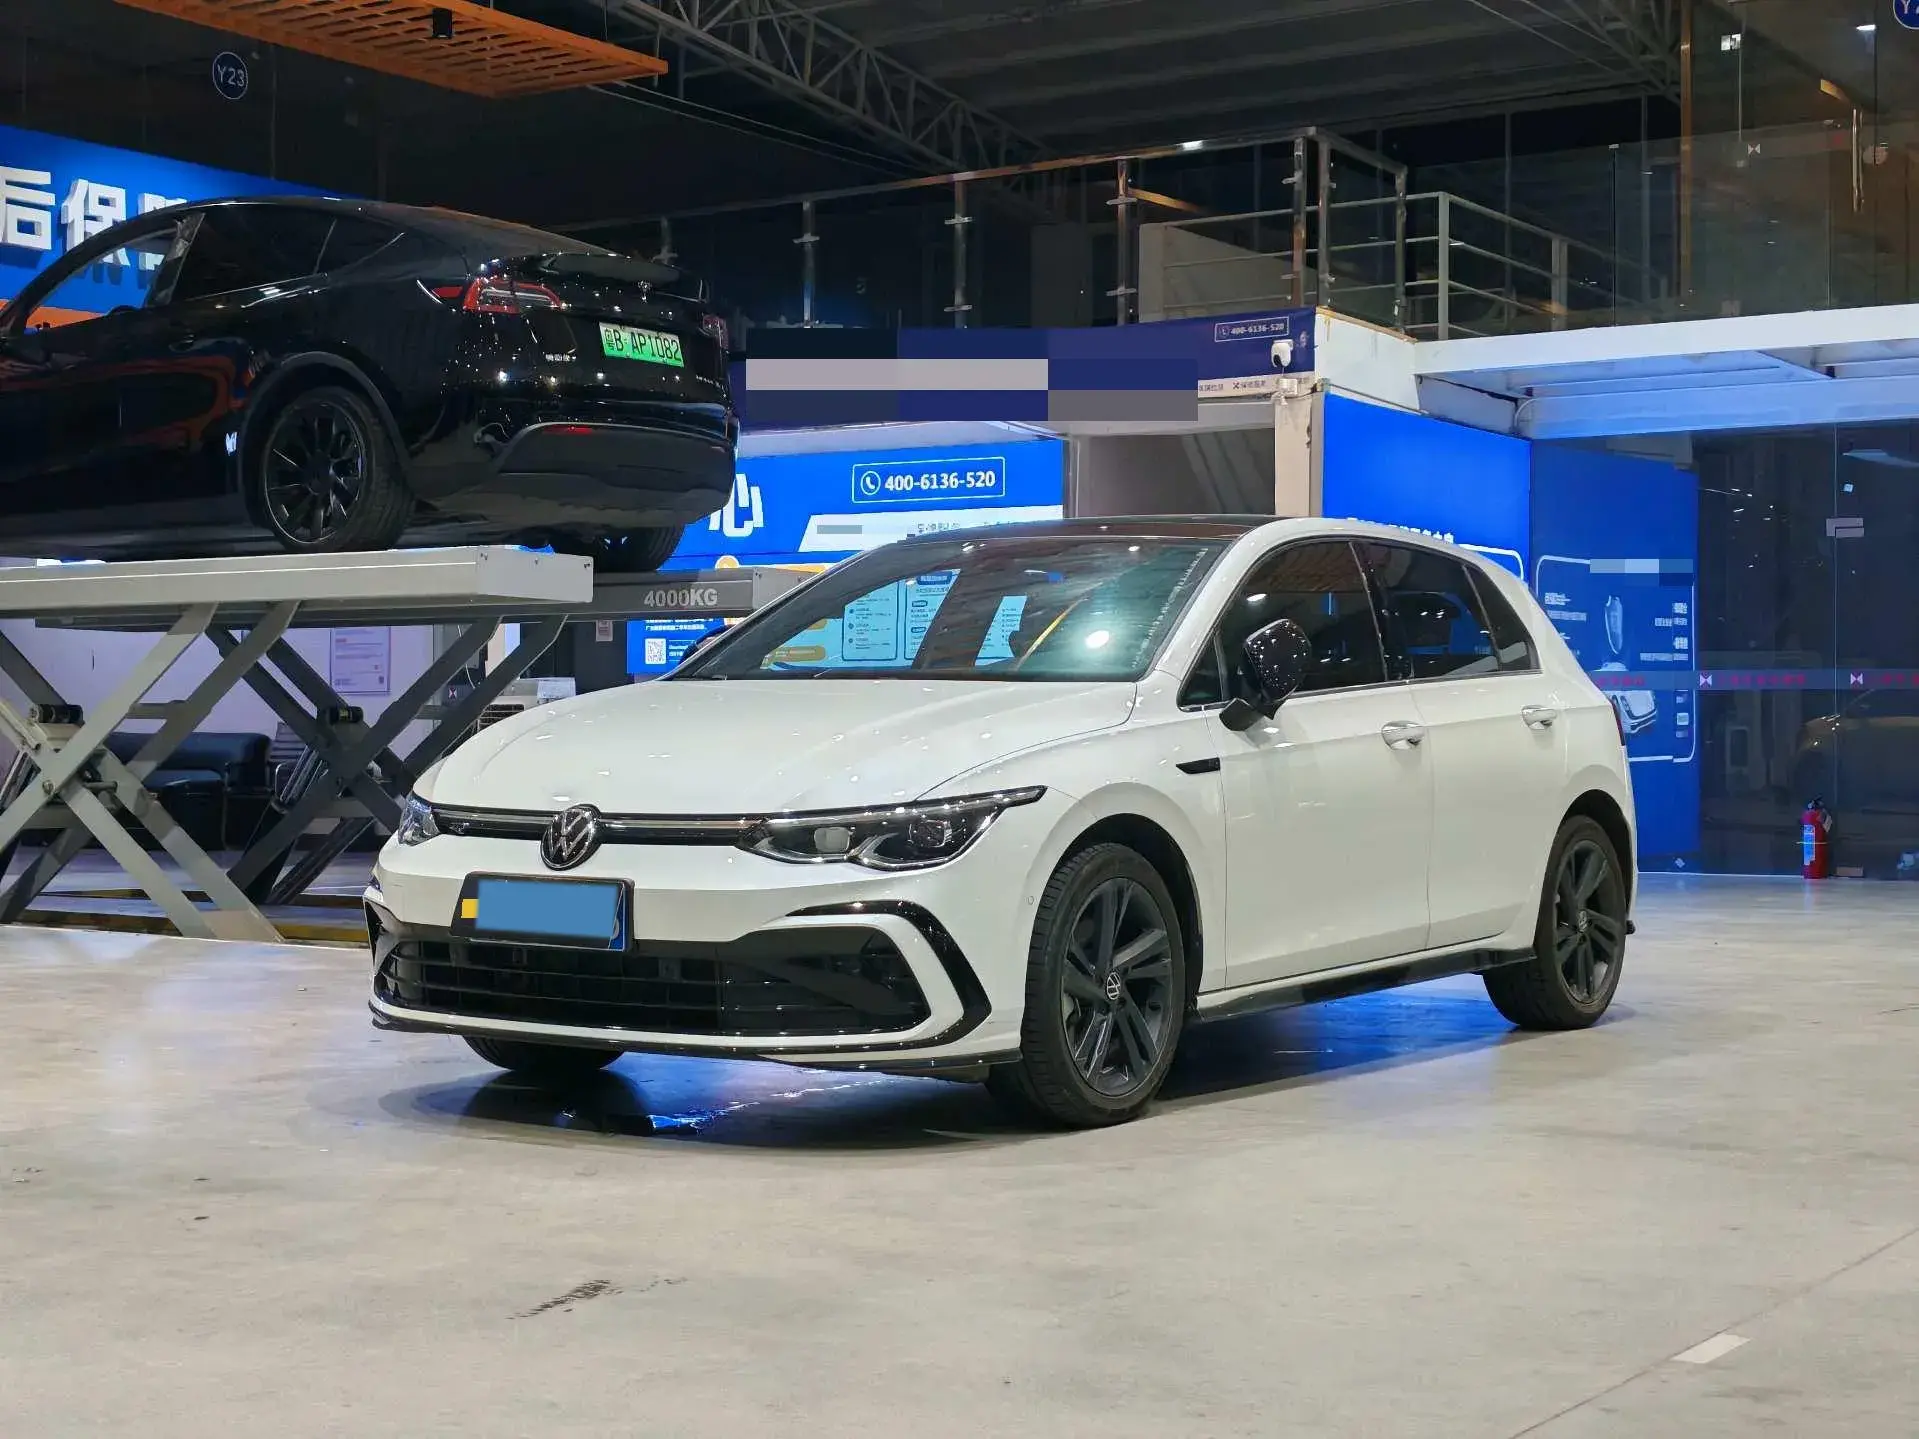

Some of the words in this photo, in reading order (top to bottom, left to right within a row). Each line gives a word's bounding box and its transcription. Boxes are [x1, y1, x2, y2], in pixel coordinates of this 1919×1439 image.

[217, 64, 245, 87] Y23
[884, 470, 996, 491] 400-6136-520
[643, 588, 719, 607] 4000KG
